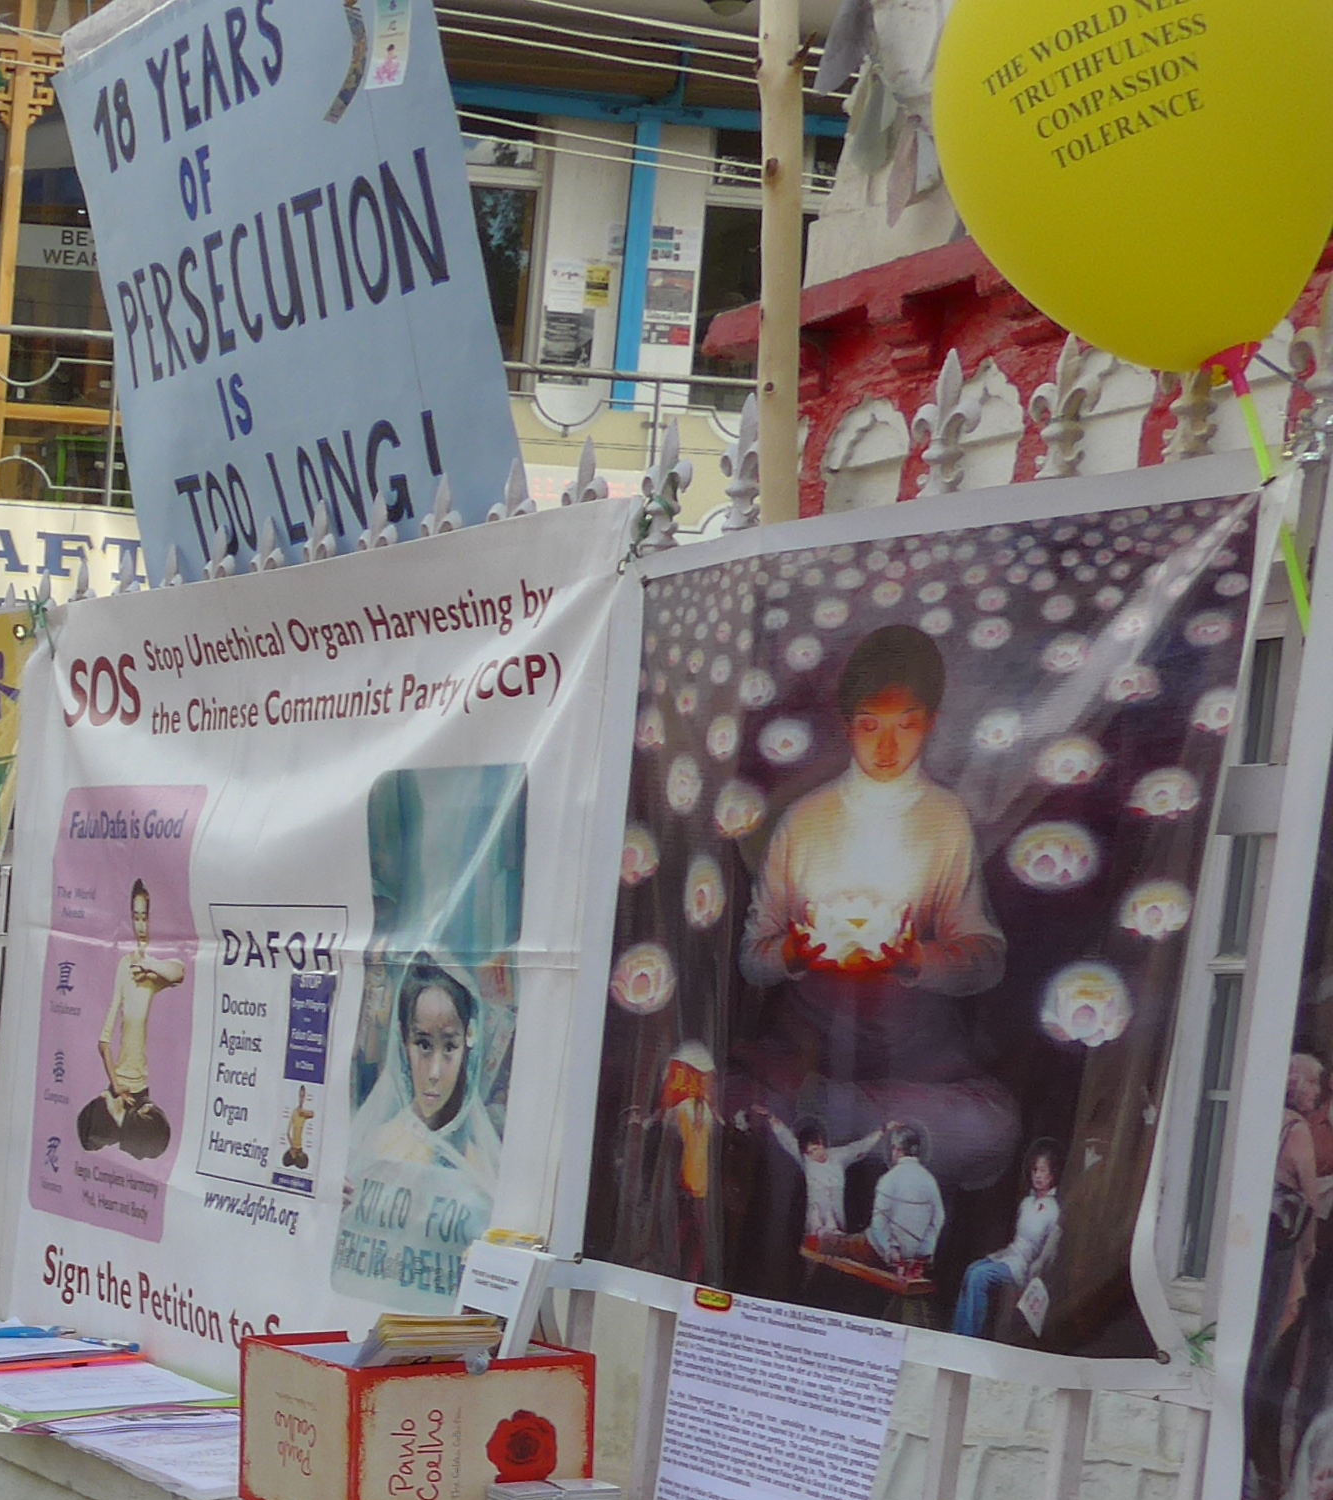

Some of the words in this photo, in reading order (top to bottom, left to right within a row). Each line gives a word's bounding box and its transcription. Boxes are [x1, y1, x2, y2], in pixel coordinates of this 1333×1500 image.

[93, 77, 136, 174] 18
[145, 0, 283, 145] YEARS
[982, 56, 1029, 97] THE
[1029, 3, 1127, 64] WORLD
[1009, 13, 1209, 117] TRUTHFULNESS
[1035, 52, 1202, 140] COMPASSION
[1051, 88, 1206, 170] TOLERANCE
[179, 145, 213, 221] OF
[117, 146, 451, 390] PERSECUTION
[216, 372, 253, 442] IS
[174, 463, 258, 566] TOO
[63, 653, 143, 730] SOS
[143, 637, 185, 678] Stop
[186, 619, 285, 668] Unethical
[288, 608, 365, 661] Organ
[364, 587, 515, 643] Harvesting
[520, 577, 554, 627] by
[150, 701, 181, 736] the
[185, 695, 259, 732] Chinese
[264, 677, 393, 728] Communist
[399, 670, 465, 717] Party
[463, 650, 563, 714] (CCP)
[142, 809, 188, 840] Good
[221, 928, 337, 971] DAFOH
[218, 1027, 263, 1056] Against
[221, 993, 268, 1019] Doctors
[213, 1096, 249, 1126] Organ
[215, 1062, 257, 1088] Forced
[208, 1129, 270, 1168] Harvesting
[203, 1189, 300, 1236] www.dafoh.org
[425, 1195, 472, 1246] FOR
[42, 1242, 91, 1305] Sign
[95, 1261, 133, 1311] the
[137, 1271, 224, 1341] Petition
[274, 1409, 317, 1448] Coelho
[388, 1417, 416, 1497] Paulo
